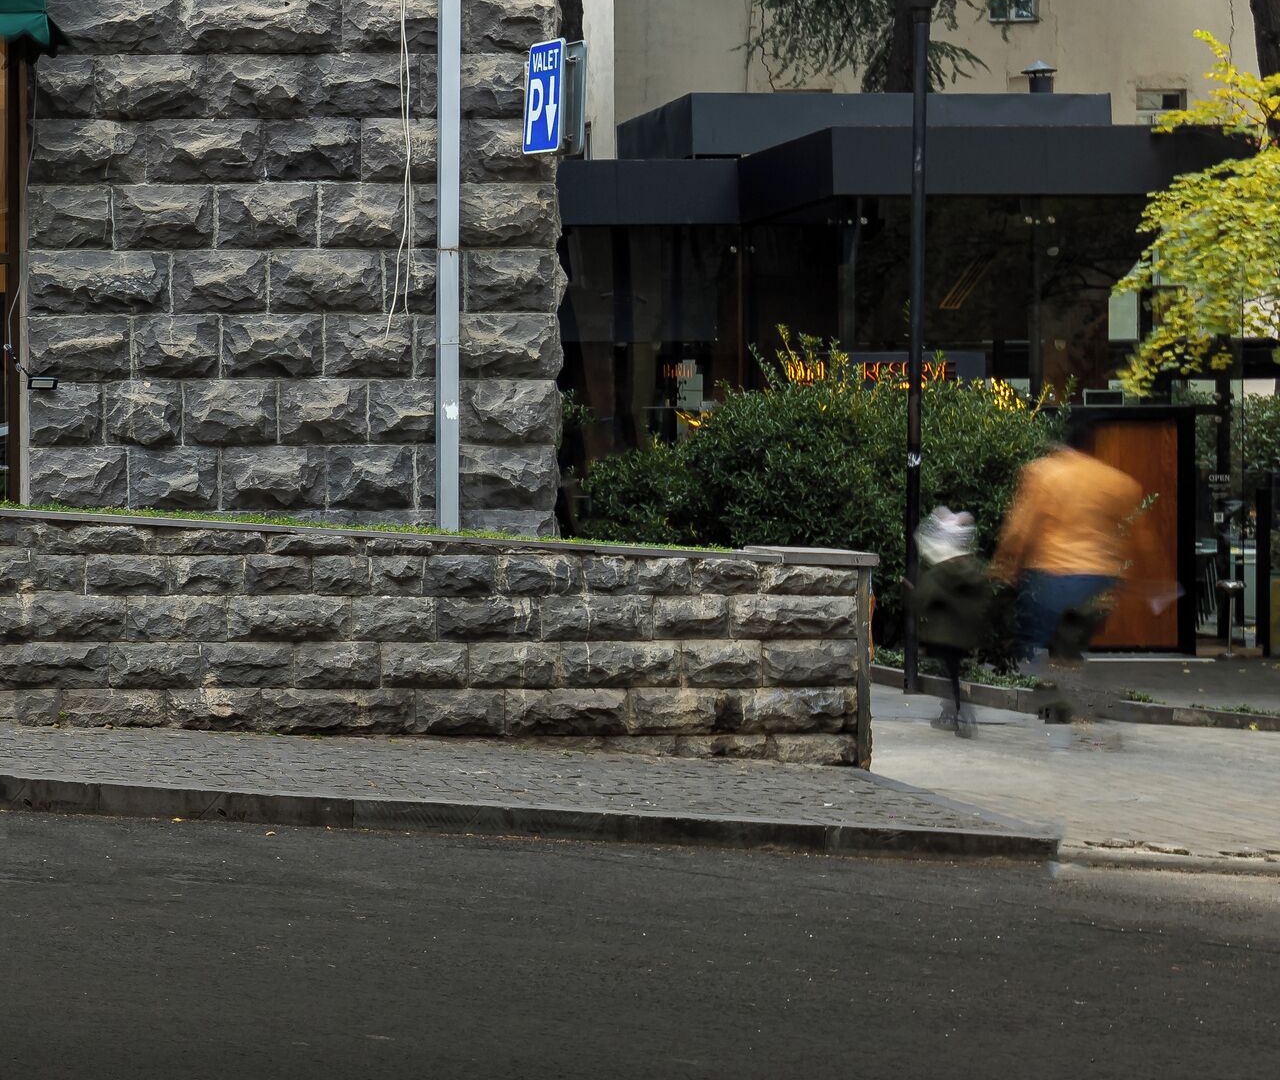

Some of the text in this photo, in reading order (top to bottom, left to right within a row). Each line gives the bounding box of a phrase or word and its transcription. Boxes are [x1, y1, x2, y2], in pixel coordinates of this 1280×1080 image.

[532, 48, 559, 73] VALET
[526, 78, 544, 145] P
[1208, 474, 1231, 482] OPEN
